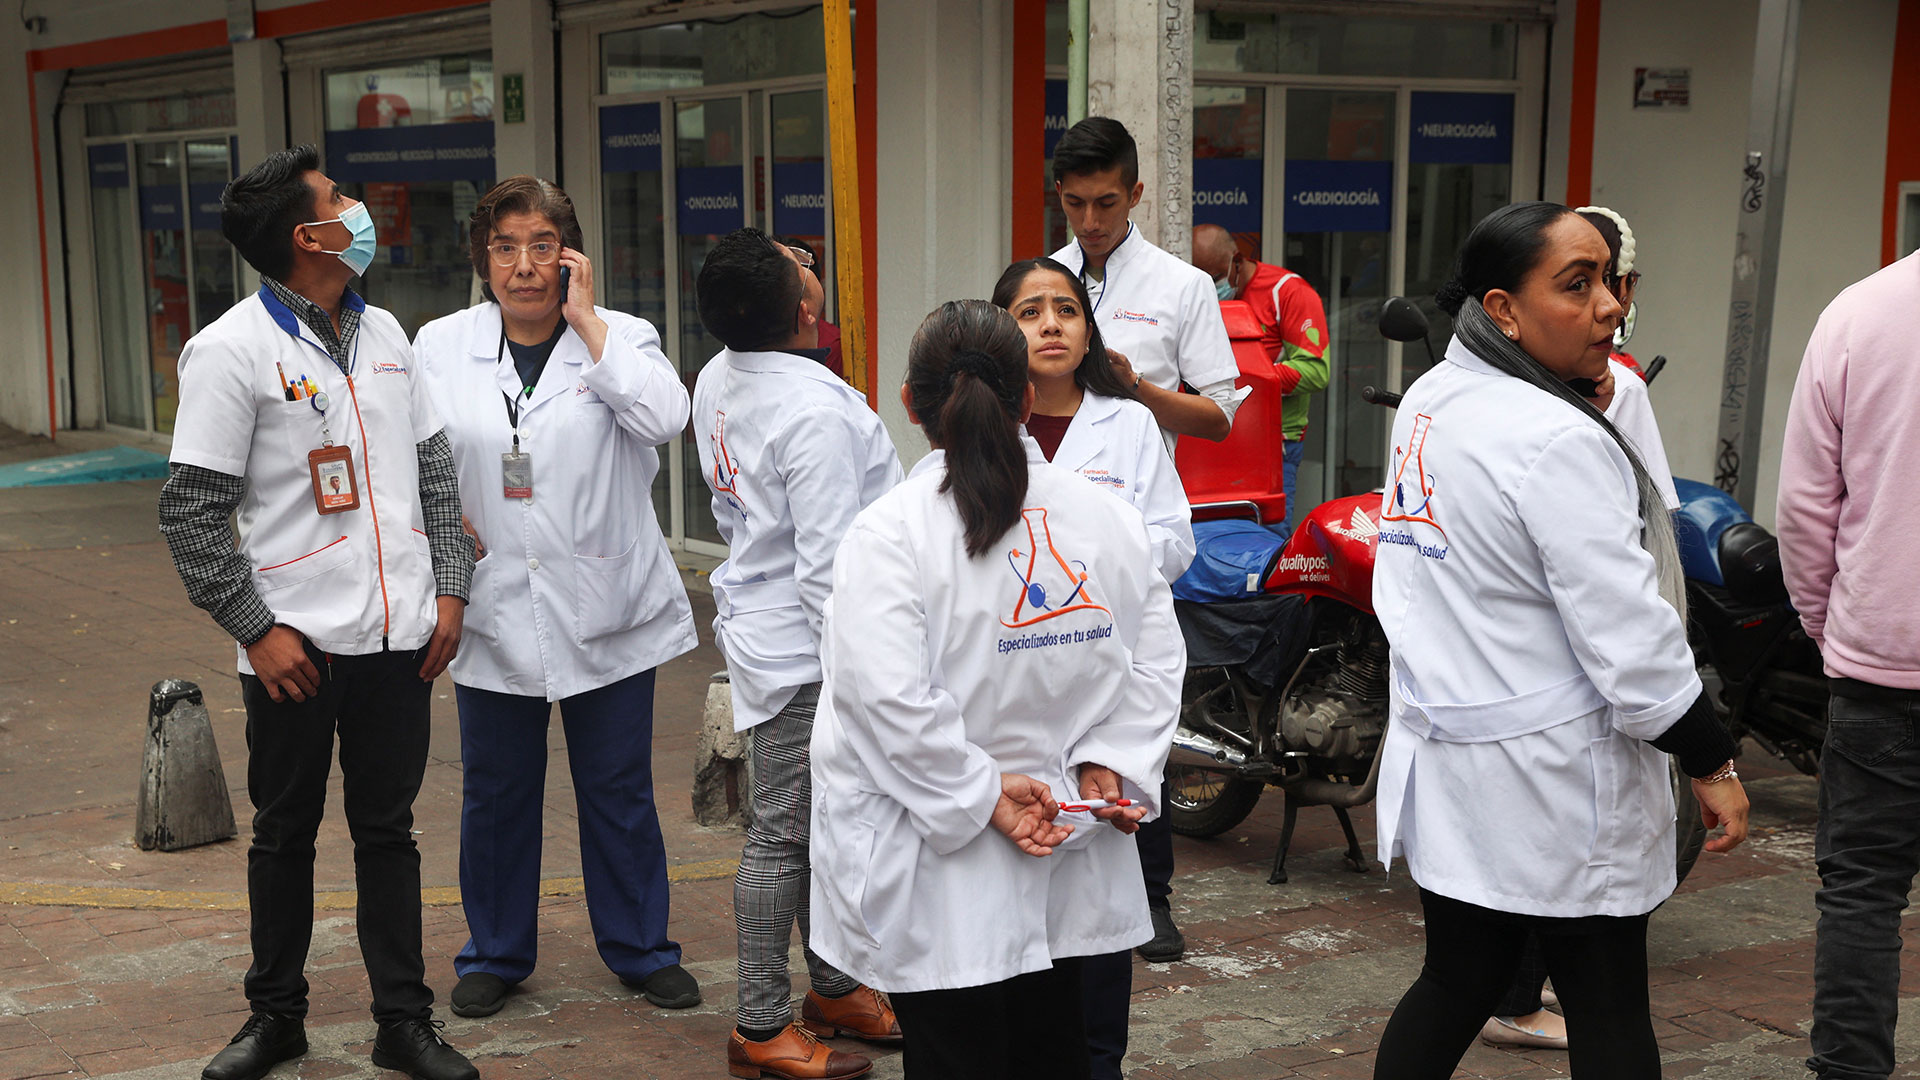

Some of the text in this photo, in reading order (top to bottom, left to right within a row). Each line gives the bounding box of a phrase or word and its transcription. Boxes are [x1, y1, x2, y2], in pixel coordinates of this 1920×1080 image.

[1422, 121, 1497, 138] NEUROLOGÍA
[608, 130, 661, 148] HEMATOLOGÍA
[688, 193, 738, 210] ONCOLOGÍA
[784, 194, 825, 209] NEUROLO
[1298, 188, 1380, 206] CARDIOLOGÍA
[1335, 527, 1371, 546] HONDA
[1422, 544, 1449, 561] salud
[1280, 553, 1330, 573] qualitypost
[1299, 573, 1309, 582] we
[998, 624, 1113, 655] Especializados en tu salud
